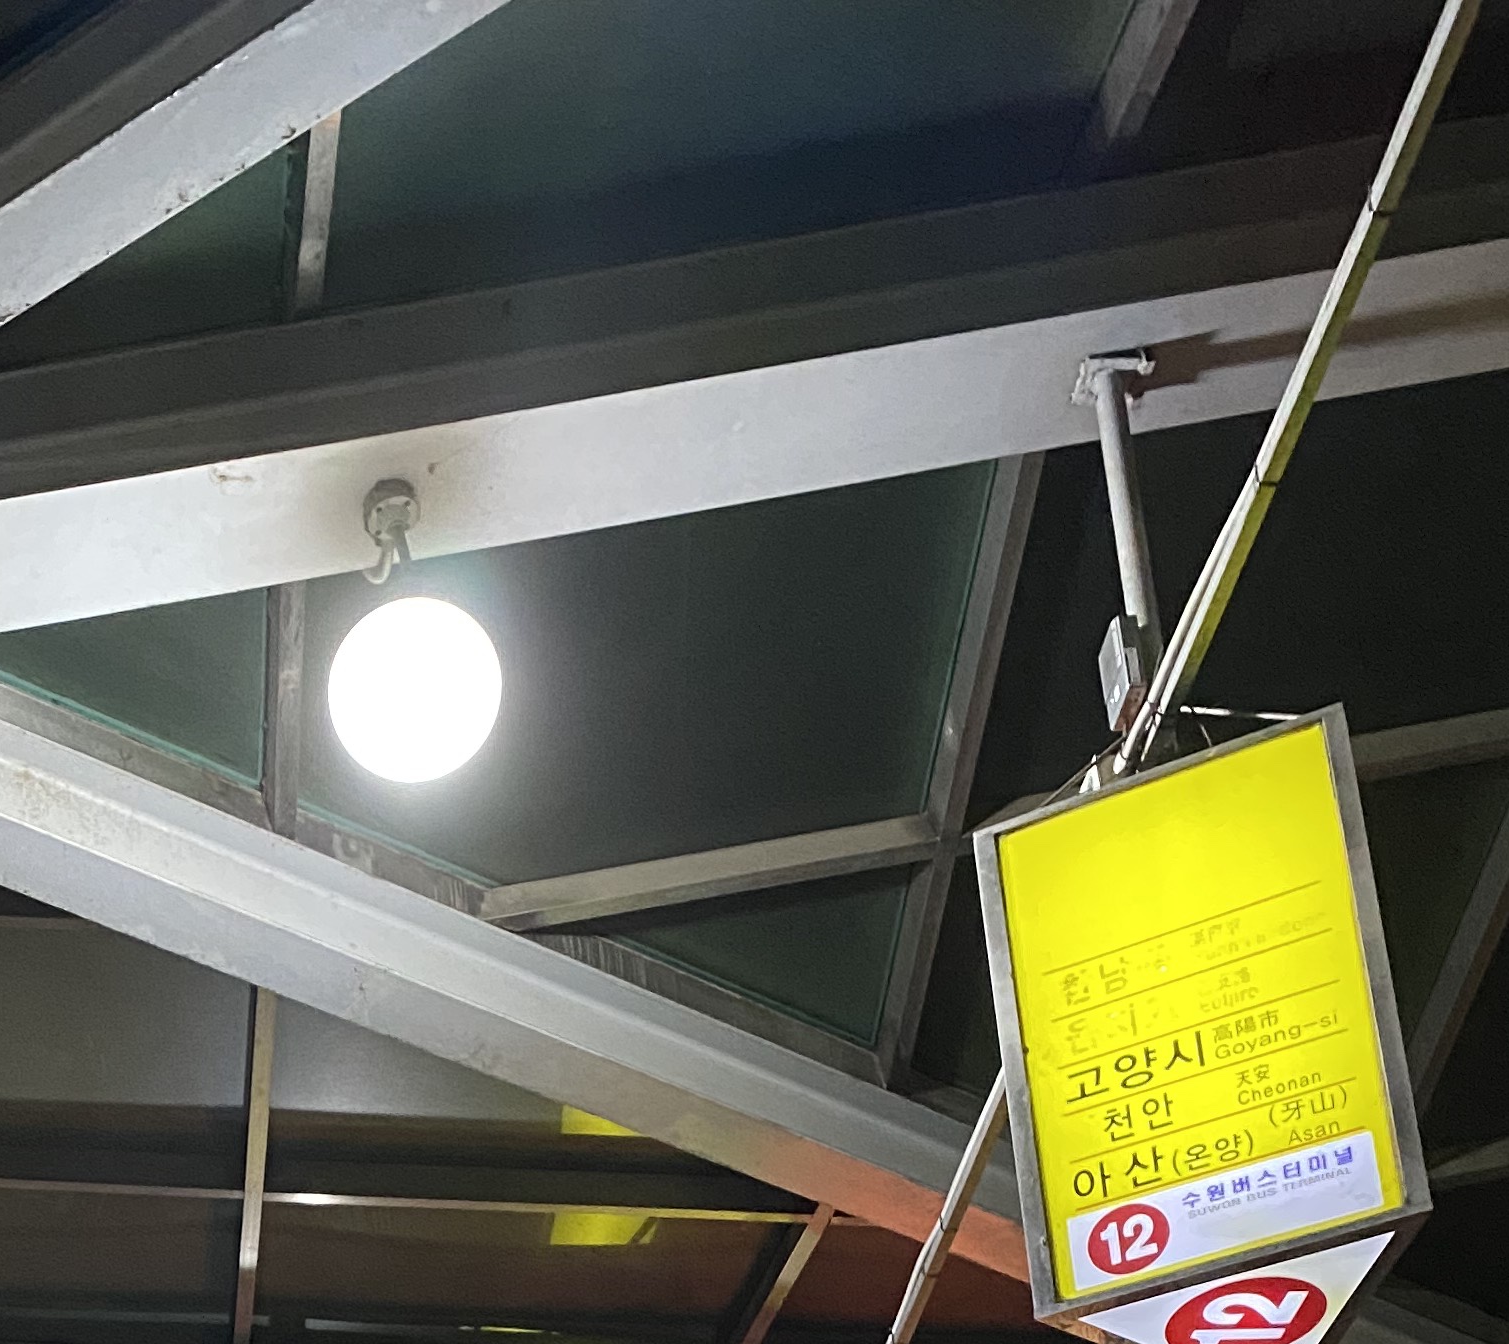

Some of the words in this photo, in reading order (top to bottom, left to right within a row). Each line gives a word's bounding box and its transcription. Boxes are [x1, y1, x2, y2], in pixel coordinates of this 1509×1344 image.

[1214, 1012, 1339, 1061] Goyang-si
[1066, 1029, 1207, 1105] 고양시
[1236, 1063, 1271, 1089] 天安
[1237, 1071, 1322, 1106] Cheonan
[1103, 1092, 1174, 1143] 천안
[1287, 1119, 1341, 1147] Asan
[1181, 1144, 1354, 1209] 수원버스터미널
[1100, 1212, 1159, 1267] 12
